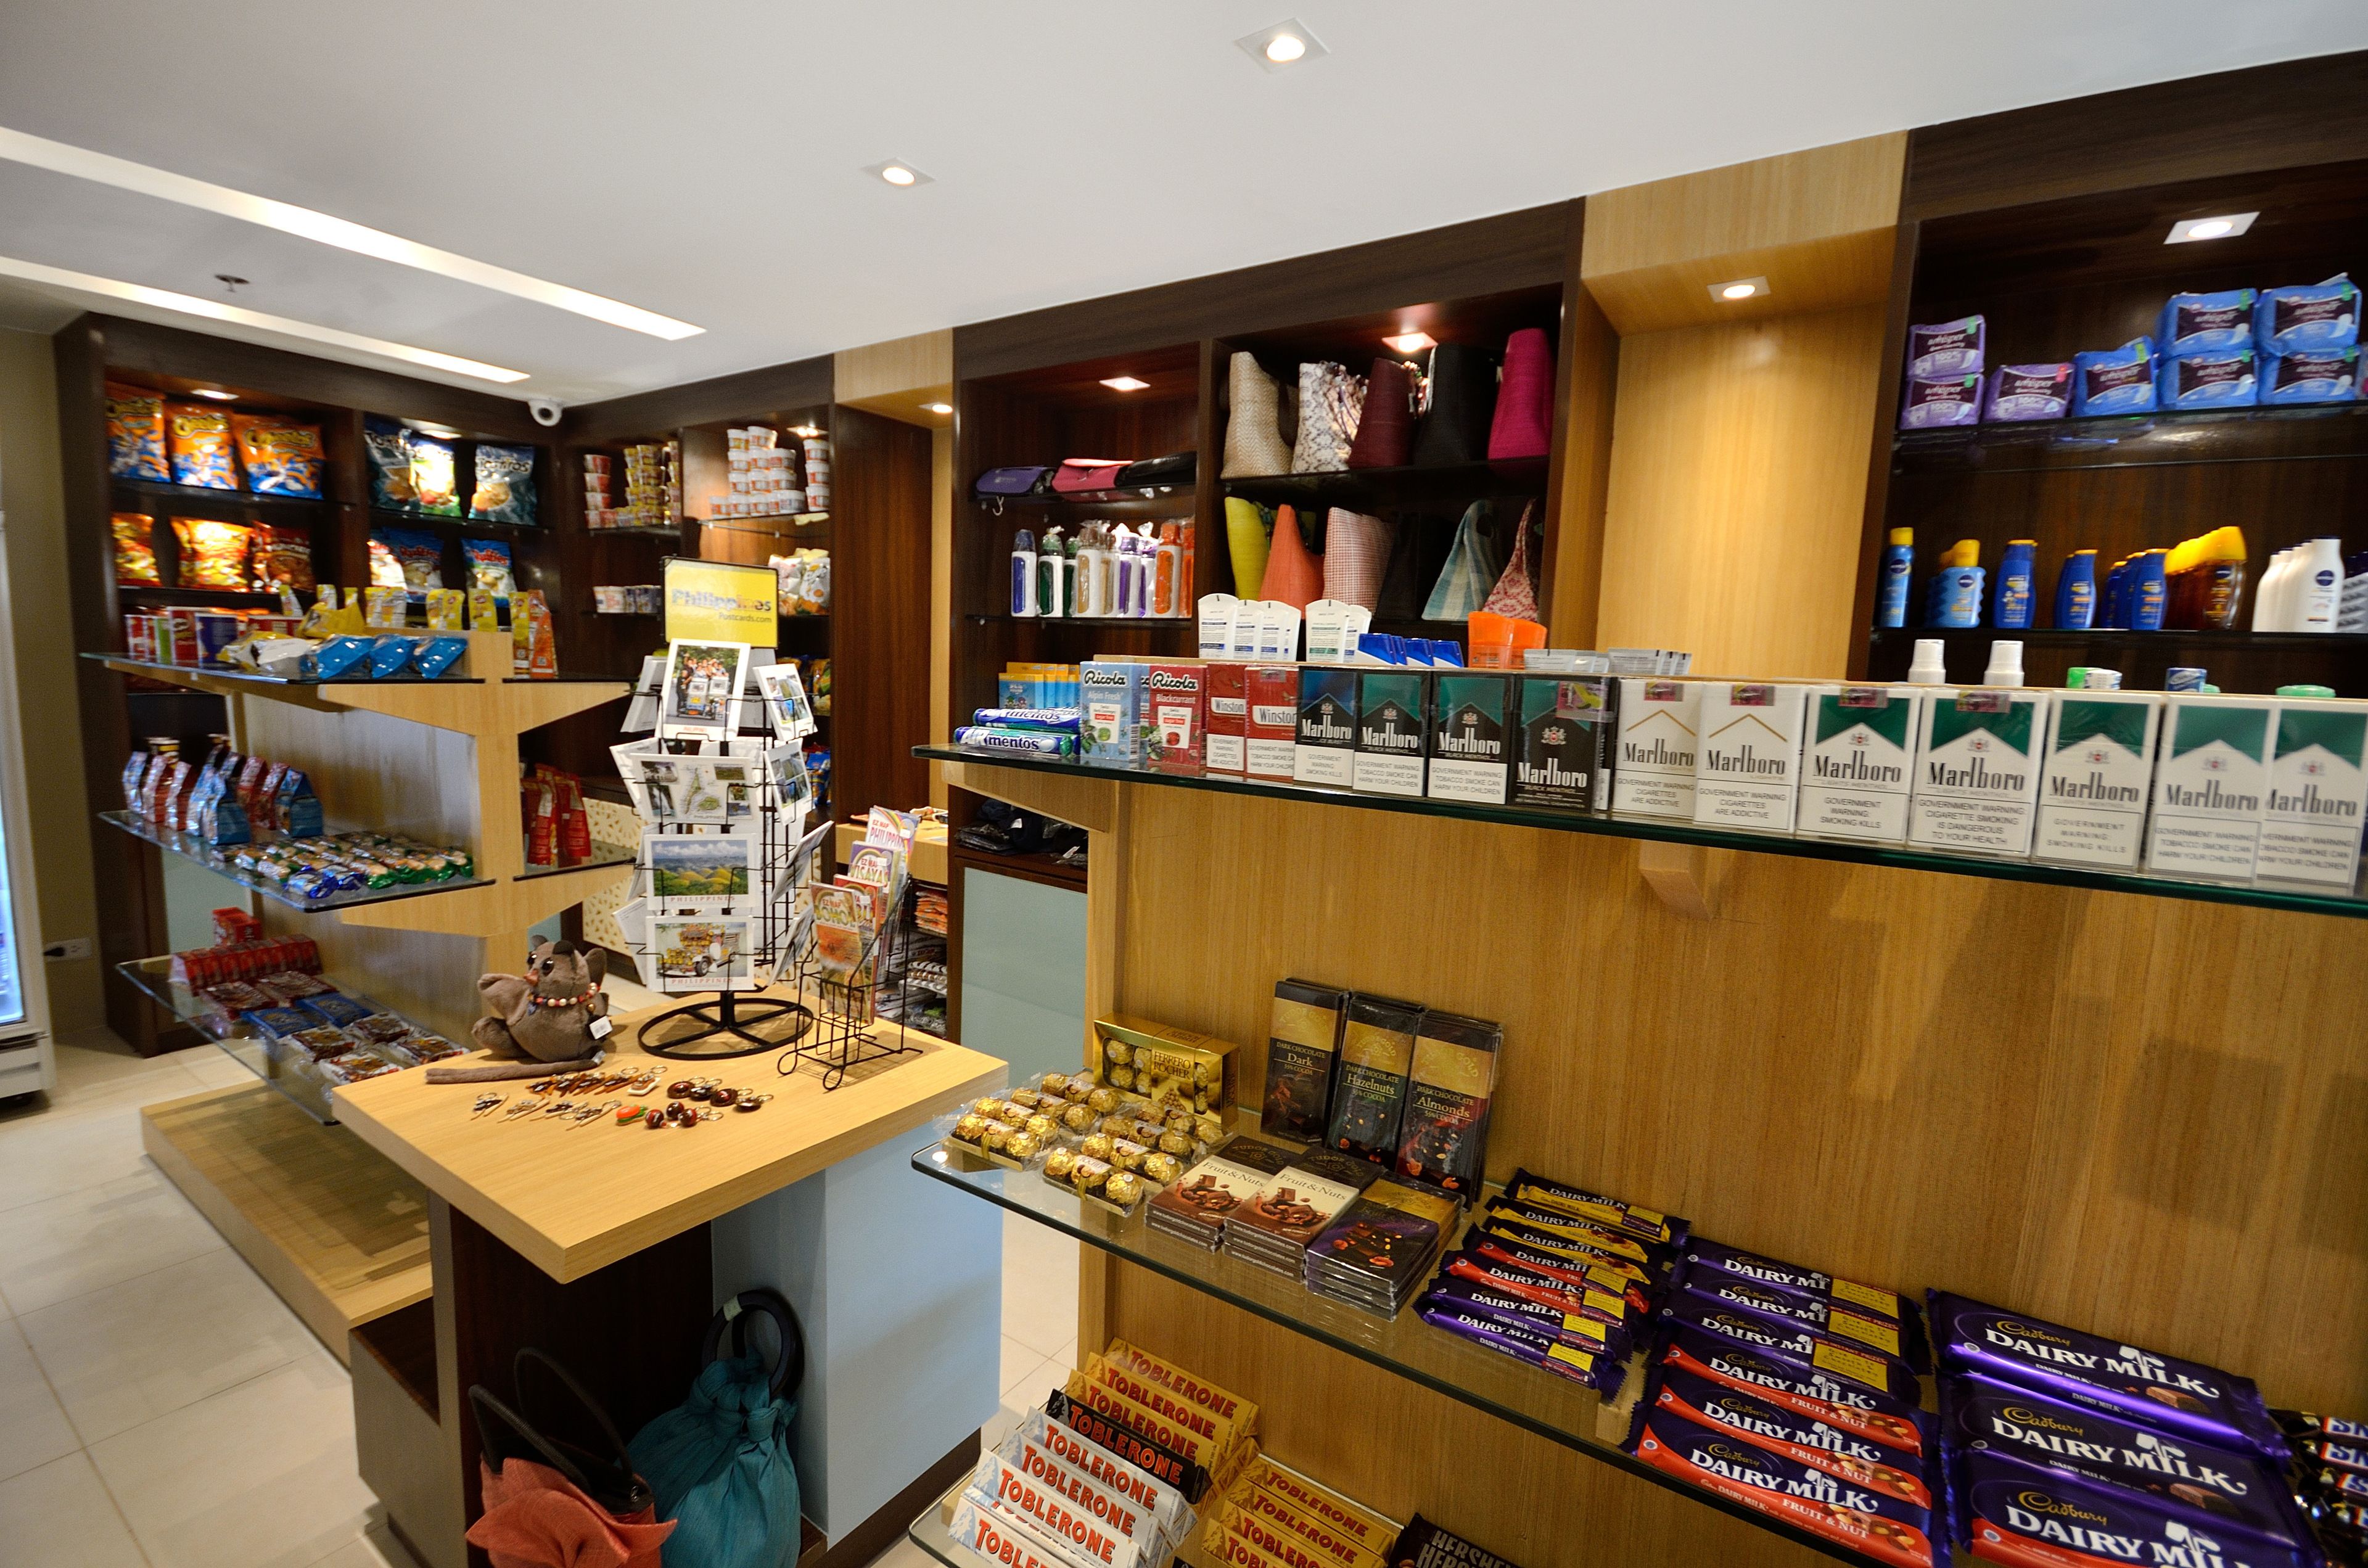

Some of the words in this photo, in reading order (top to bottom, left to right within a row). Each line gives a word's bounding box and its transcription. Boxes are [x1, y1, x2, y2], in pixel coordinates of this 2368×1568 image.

[1085, 670, 1125, 686] Ricola
[1153, 673, 1196, 689] Ricola
[1156, 694, 1196, 704] Blackcurrant
[1215, 700, 1244, 713] Winston
[1301, 715, 1352, 739] Marlboro
[1362, 723, 1418, 749] Marlboro
[988, 734, 1039, 750] mentos
[1438, 728, 1501, 755] Marlboro
[1622, 738, 1695, 766] Marlboro
[1432, 767, 1472, 775] GOVERNMENT
[1706, 744, 1785, 775] Marlboro
[1813, 750, 1901, 782] Marlboro
[1436, 776, 1464, 784] TOBACCO
[1516, 758, 1587, 787] Marlboro
[1618, 778, 1662, 788] GOVERNMENT
[1927, 757, 2025, 791] Marlboro
[1635, 789, 1677, 798] CIGARETTES
[1700, 788, 1749, 798] GOVERNMENT
[2049, 771, 2139, 802] Marlboro
[2165, 779, 2258, 811] Marlboro
[1646, 798, 1680, 807] ADDICTIVE
[1719, 799, 1766, 808] CIGARETTES
[1825, 797, 1881, 808] GOVERNMENT
[1919, 799, 1979, 811] GOVERNMENT
[1731, 810, 1770, 819] ADDICTIVE
[1820, 816, 1857, 826] SMOKING
[1859, 820, 1881, 829] KILLS
[1925, 810, 1975, 821] CIGARETTE
[1977, 815, 2019, 824] SMOKING
[2054, 818, 2124, 831] GOVERNMENT
[1947, 823, 2004, 834] DANGEROUS
[1947, 832, 1971, 842] YOUR
[1973, 835, 2007, 844] HEALTH
[2046, 839, 2094, 849] SMOKING
[2097, 842, 2126, 853] KILLS
[1154, 1051, 1191, 1070] FERRERO
[1288, 1053, 1313, 1067] Dark
[1291, 1045, 1325, 1059] CHOCOLATE
[1153, 1061, 1190, 1079] ROCHER
[1361, 1069, 1399, 1084] CHOCOLATE
[1347, 1074, 1395, 1095] Hazelnuts
[1363, 1091, 1386, 1102] COCOA
[1417, 1096, 1470, 1118] Almonds
[1433, 1089, 1474, 1106] CHOCOLATE
[1202, 1162, 1228, 1174] Fruit
[1228, 1170, 1240, 1178] &
[1241, 1174, 1265, 1188] Nuts
[1279, 1173, 1305, 1188] Fruit
[1307, 1183, 1318, 1191] &
[1321, 1186, 1347, 1201] Nuts
[1550, 1188, 1592, 1202] DAIRY
[1593, 1197, 1627, 1209] MILK
[1525, 1211, 1566, 1226] DAIRY
[1568, 1220, 1608, 1232] MILK
[1523, 1233, 1565, 1249] DAIRY
[1566, 1242, 1608, 1256] MILK
[1516, 1251, 1560, 1268] DAIRY
[1489, 1267, 1536, 1286] DAIRY
[1537, 1277, 1582, 1294] MILK
[1724, 1259, 1795, 1284] DAIRY
[1470, 1293, 1519, 1310] DAIRY
[1520, 1303, 1563, 1318] MILK
[1541, 1292, 1561, 1302] FRUIT
[1719, 1289, 1793, 1314] DAIRY
[1457, 1314, 1506, 1333] DAIRY
[1493, 1313, 1512, 1324] DAIRY
[1513, 1320, 1532, 1330] MILK
[1701, 1318, 1778, 1345] DAIRY
[1996, 1321, 2071, 1347] Cadbury
[1480, 1337, 1498, 1348] DAIRY
[1500, 1344, 1517, 1356] MILK
[1985, 1328, 2100, 1369] DAIRY
[2104, 1357, 2219, 1399] MILK
[2036, 1363, 2063, 1376] DAIRY
[2064, 1371, 2090, 1384] MILK
[1128, 1350, 1238, 1419] TOBLERONE
[1709, 1358, 1793, 1390] DAIRY
[1794, 1383, 1877, 1410] MILK
[1106, 1368, 1215, 1441] TOBLERONE
[1720, 1398, 1770, 1419] Cadbury
[1791, 1397, 1828, 1415] FRUIT
[1840, 1414, 1868, 1429] NUT
[2072, 1392, 2097, 1406] DAIRY
[2098, 1400, 2121, 1413] MILK
[1088, 1385, 1199, 1461] TOBLERONE
[1704, 1402, 1793, 1439] DAIRY
[1794, 1430, 1881, 1462] MILK
[2003, 1406, 2084, 1437] Cadbury
[1069, 1405, 1183, 1485] TOBLERONE
[1708, 1443, 1761, 1467] Cadbury
[1991, 1416, 2122, 1463] DAIRY
[2124, 1450, 2247, 1495] MILK
[1045, 1424, 1157, 1511] TOBLERONE
[1790, 1447, 1828, 1468] FRUIT
[1832, 1464, 1841, 1472] &
[1841, 1467, 1873, 1485] NUT
[2049, 1459, 2079, 1474] DAIRY
[2081, 1469, 2108, 1482] MILK
[1022, 1444, 1136, 1537] TOBLERONE
[1689, 1449, 1785, 1490] DAIRY
[1786, 1481, 1879, 1513] MILK
[1267, 1472, 1369, 1537] TOBLERONE
[1717, 1485, 1743, 1500] DAIRY
[1744, 1495, 1766, 1511] MILK
[2018, 1491, 2108, 1526] Cadbury
[998, 1468, 1116, 1565] TOBLERONE
[1782, 1498, 1823, 1521] FRUIT
[1826, 1516, 1836, 1525] &
[1838, 1522, 1869, 1540] NUT
[1253, 1495, 1357, 1564] TOBLERONE
[2006, 1505, 2145, 1559] DAIRY
